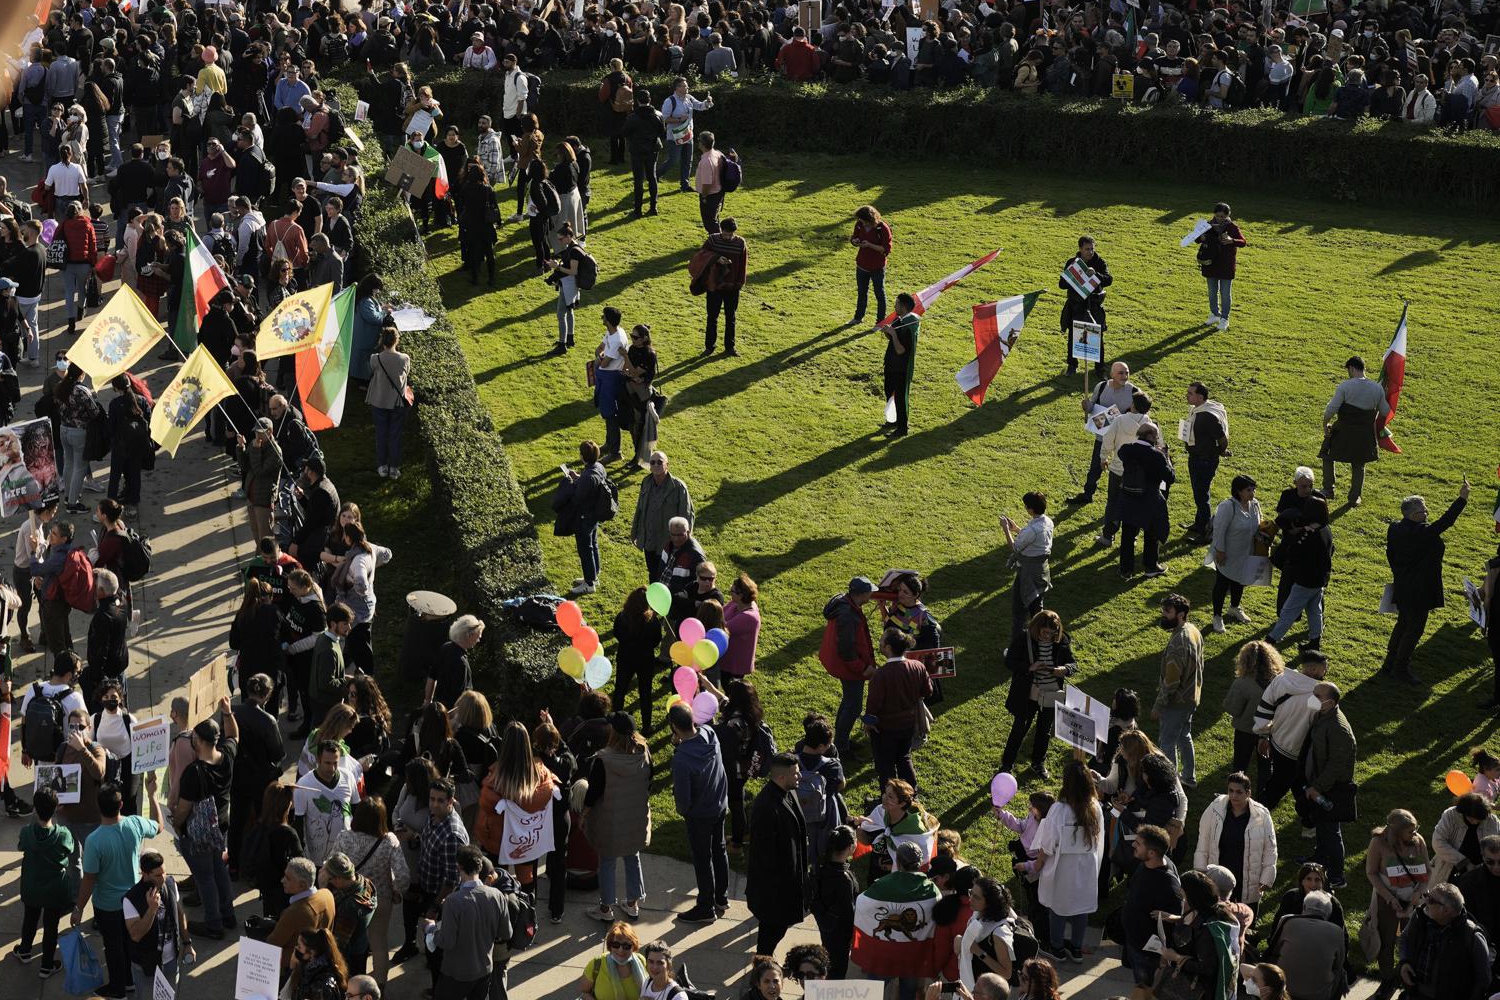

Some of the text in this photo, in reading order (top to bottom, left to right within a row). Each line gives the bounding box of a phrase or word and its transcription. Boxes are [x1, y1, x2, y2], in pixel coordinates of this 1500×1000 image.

[4, 486, 27, 500] LIFE
[136, 740, 162, 757] Life
[134, 756, 166, 772] Freedom
[508, 825, 543, 845] آزادی
